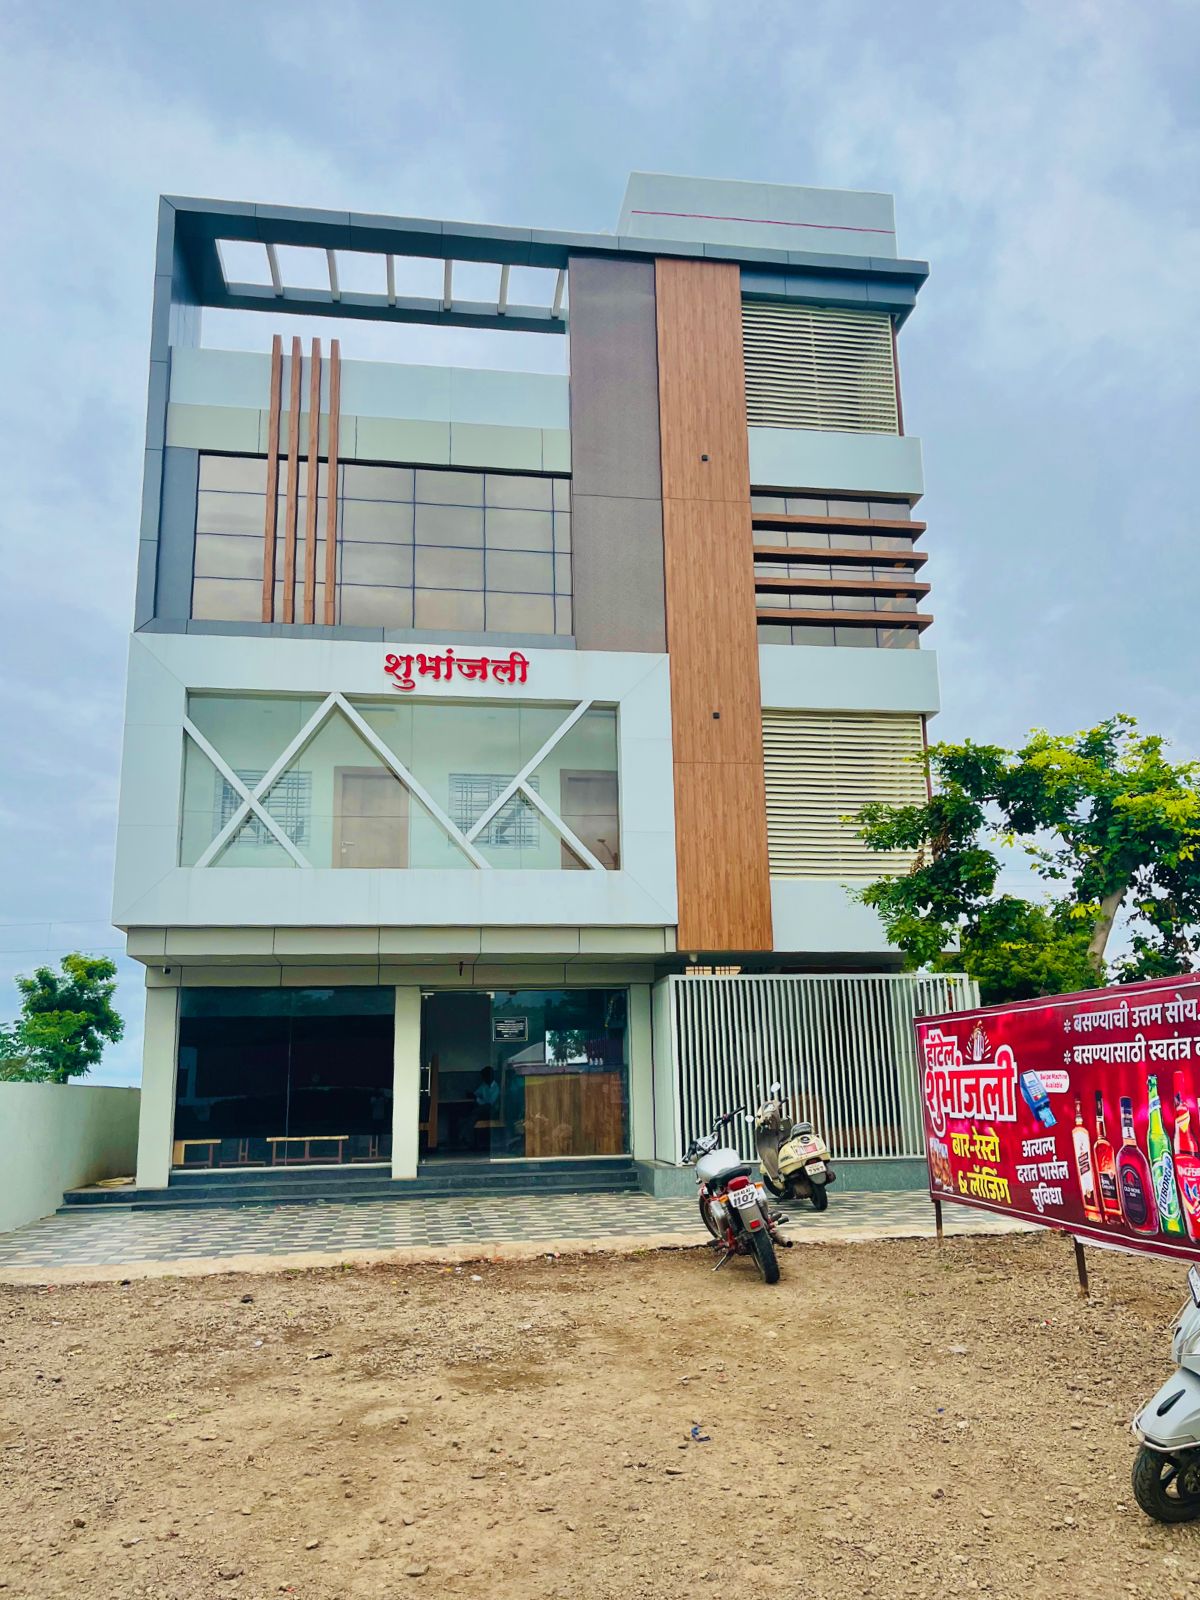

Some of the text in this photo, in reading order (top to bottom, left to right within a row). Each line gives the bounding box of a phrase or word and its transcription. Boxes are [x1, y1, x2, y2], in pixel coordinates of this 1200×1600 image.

[384, 648, 529, 691] शुभांजली
[1073, 1000, 1129, 1032] बसण्याची
[1130, 1003, 1163, 1028] उत्तम
[1073, 1033, 1147, 1065] बसण्यासाठी
[1148, 1031, 1192, 1061] स्वतंत्र
[925, 1049, 1015, 1134] शुभांजली
[1022, 1136, 1056, 1158] अत्यल्प
[967, 1164, 1013, 1204] लॉजिंग
[1015, 1155, 1070, 1184] दरात पार्सल
[733, 1191, 755, 1206] 1107
[1030, 1182, 1064, 1213] सुविधा
